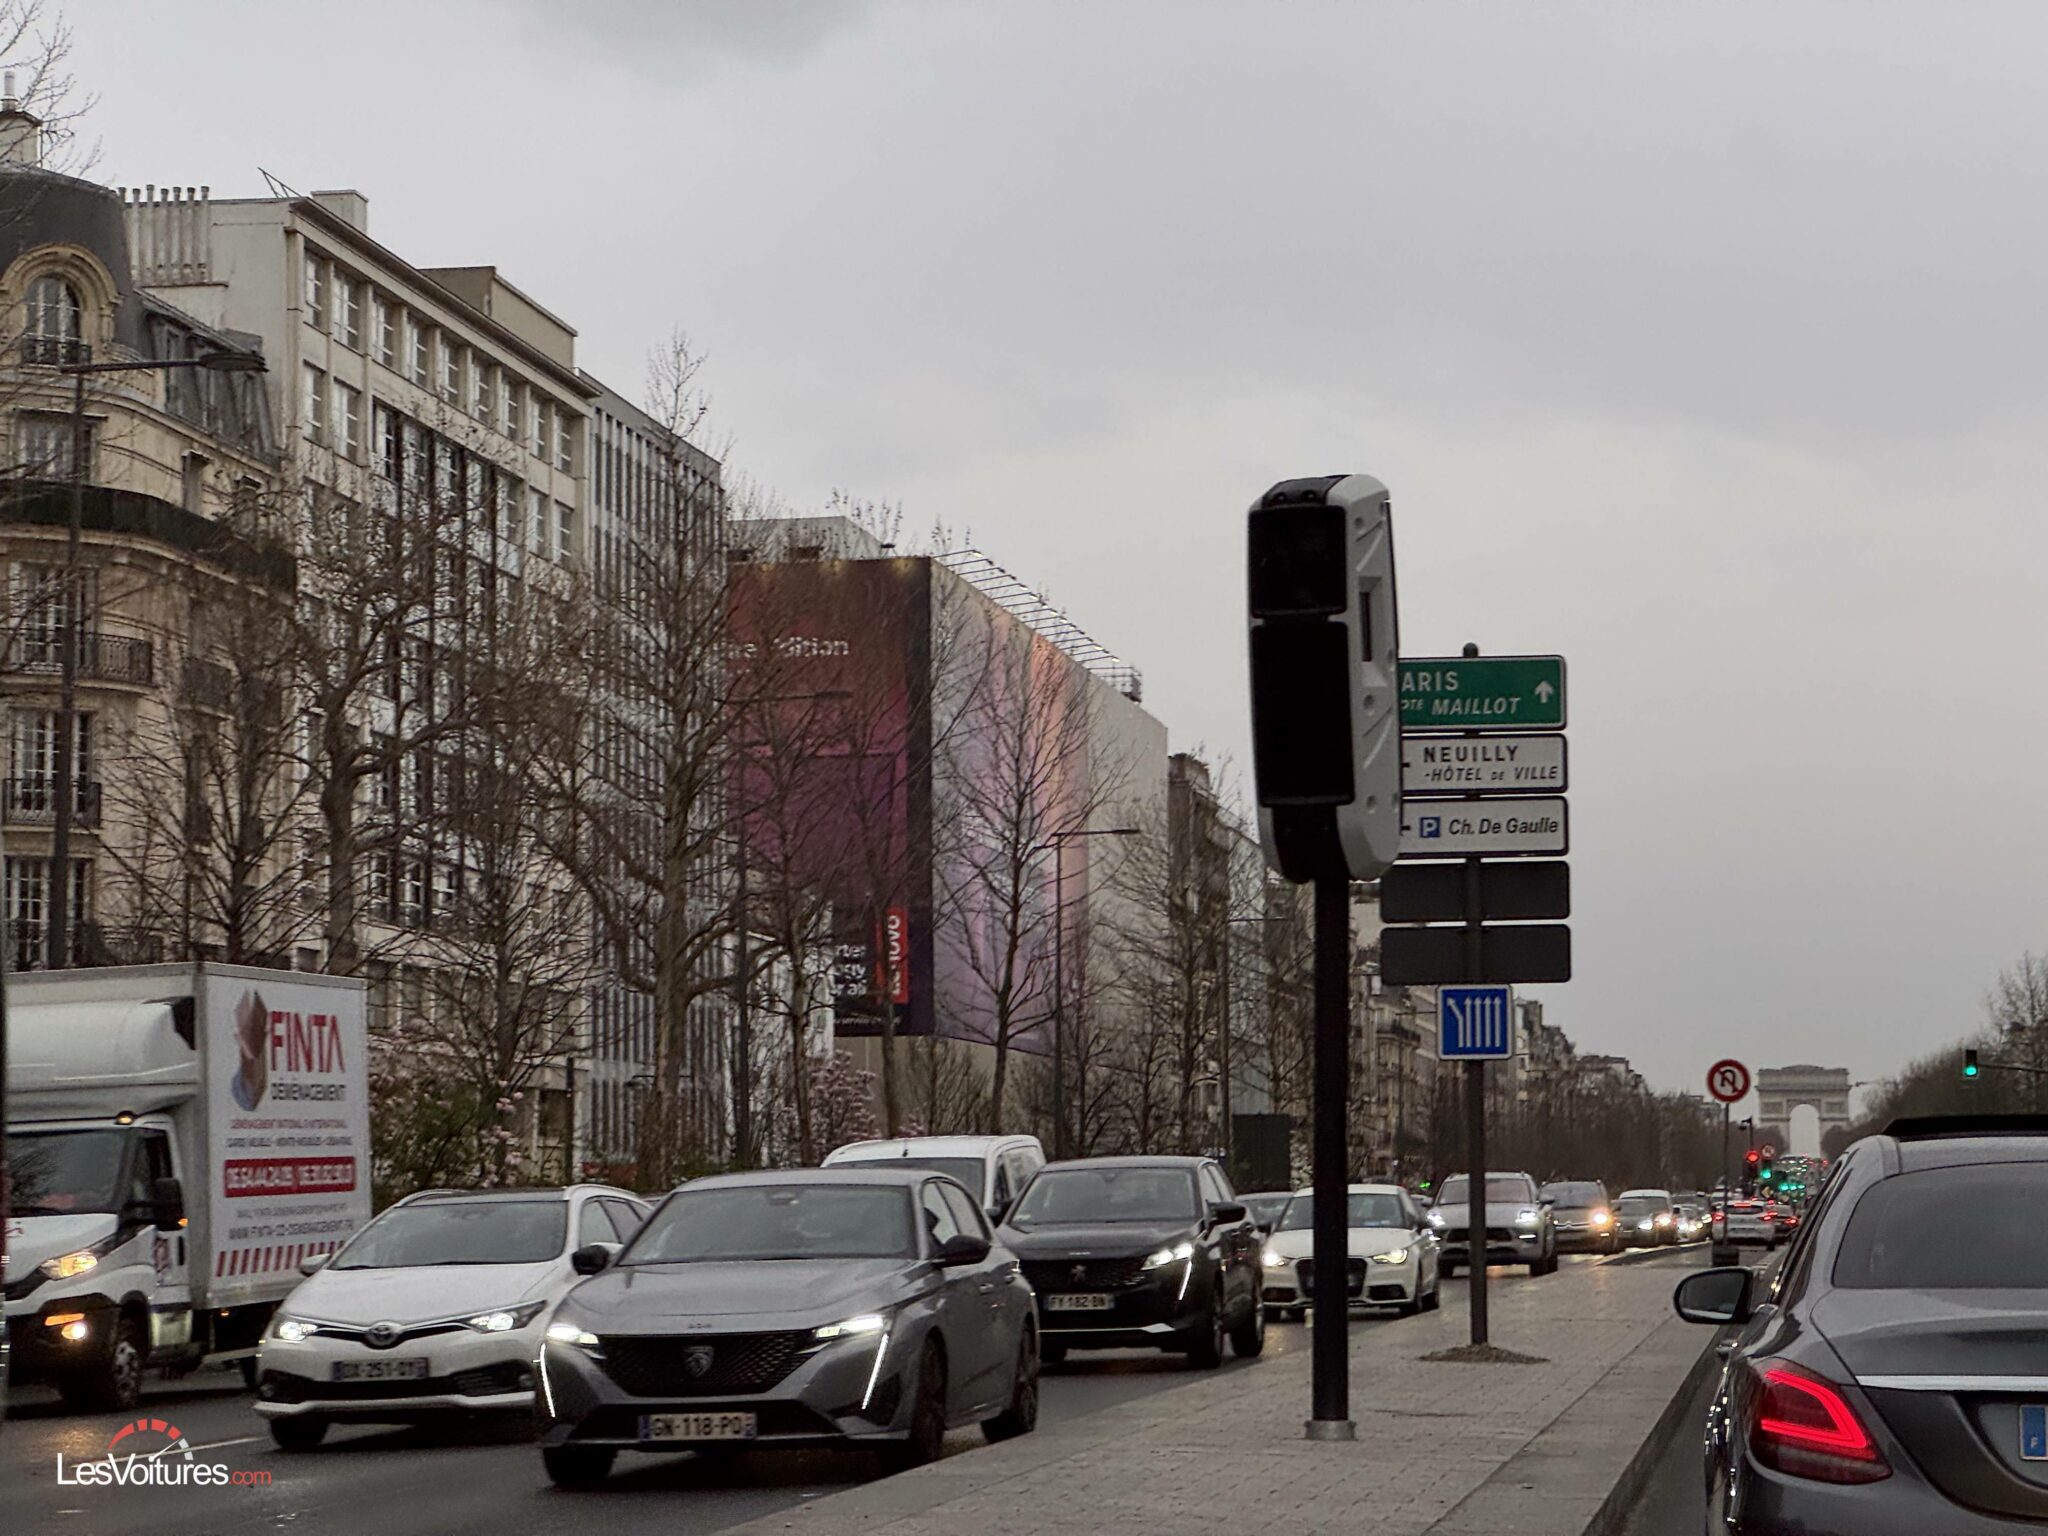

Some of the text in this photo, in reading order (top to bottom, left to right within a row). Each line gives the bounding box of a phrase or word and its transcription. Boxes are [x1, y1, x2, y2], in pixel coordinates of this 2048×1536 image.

[1401, 671, 1459, 692] ARIS
[1432, 697, 1521, 715] MAILLOT
[1423, 745, 1519, 763] NEUILLY
[1514, 766, 1558, 780] VILLE
[1422, 817, 1558, 836] P Ch. De Gaulle
[270, 1011, 346, 1073] FINTA
